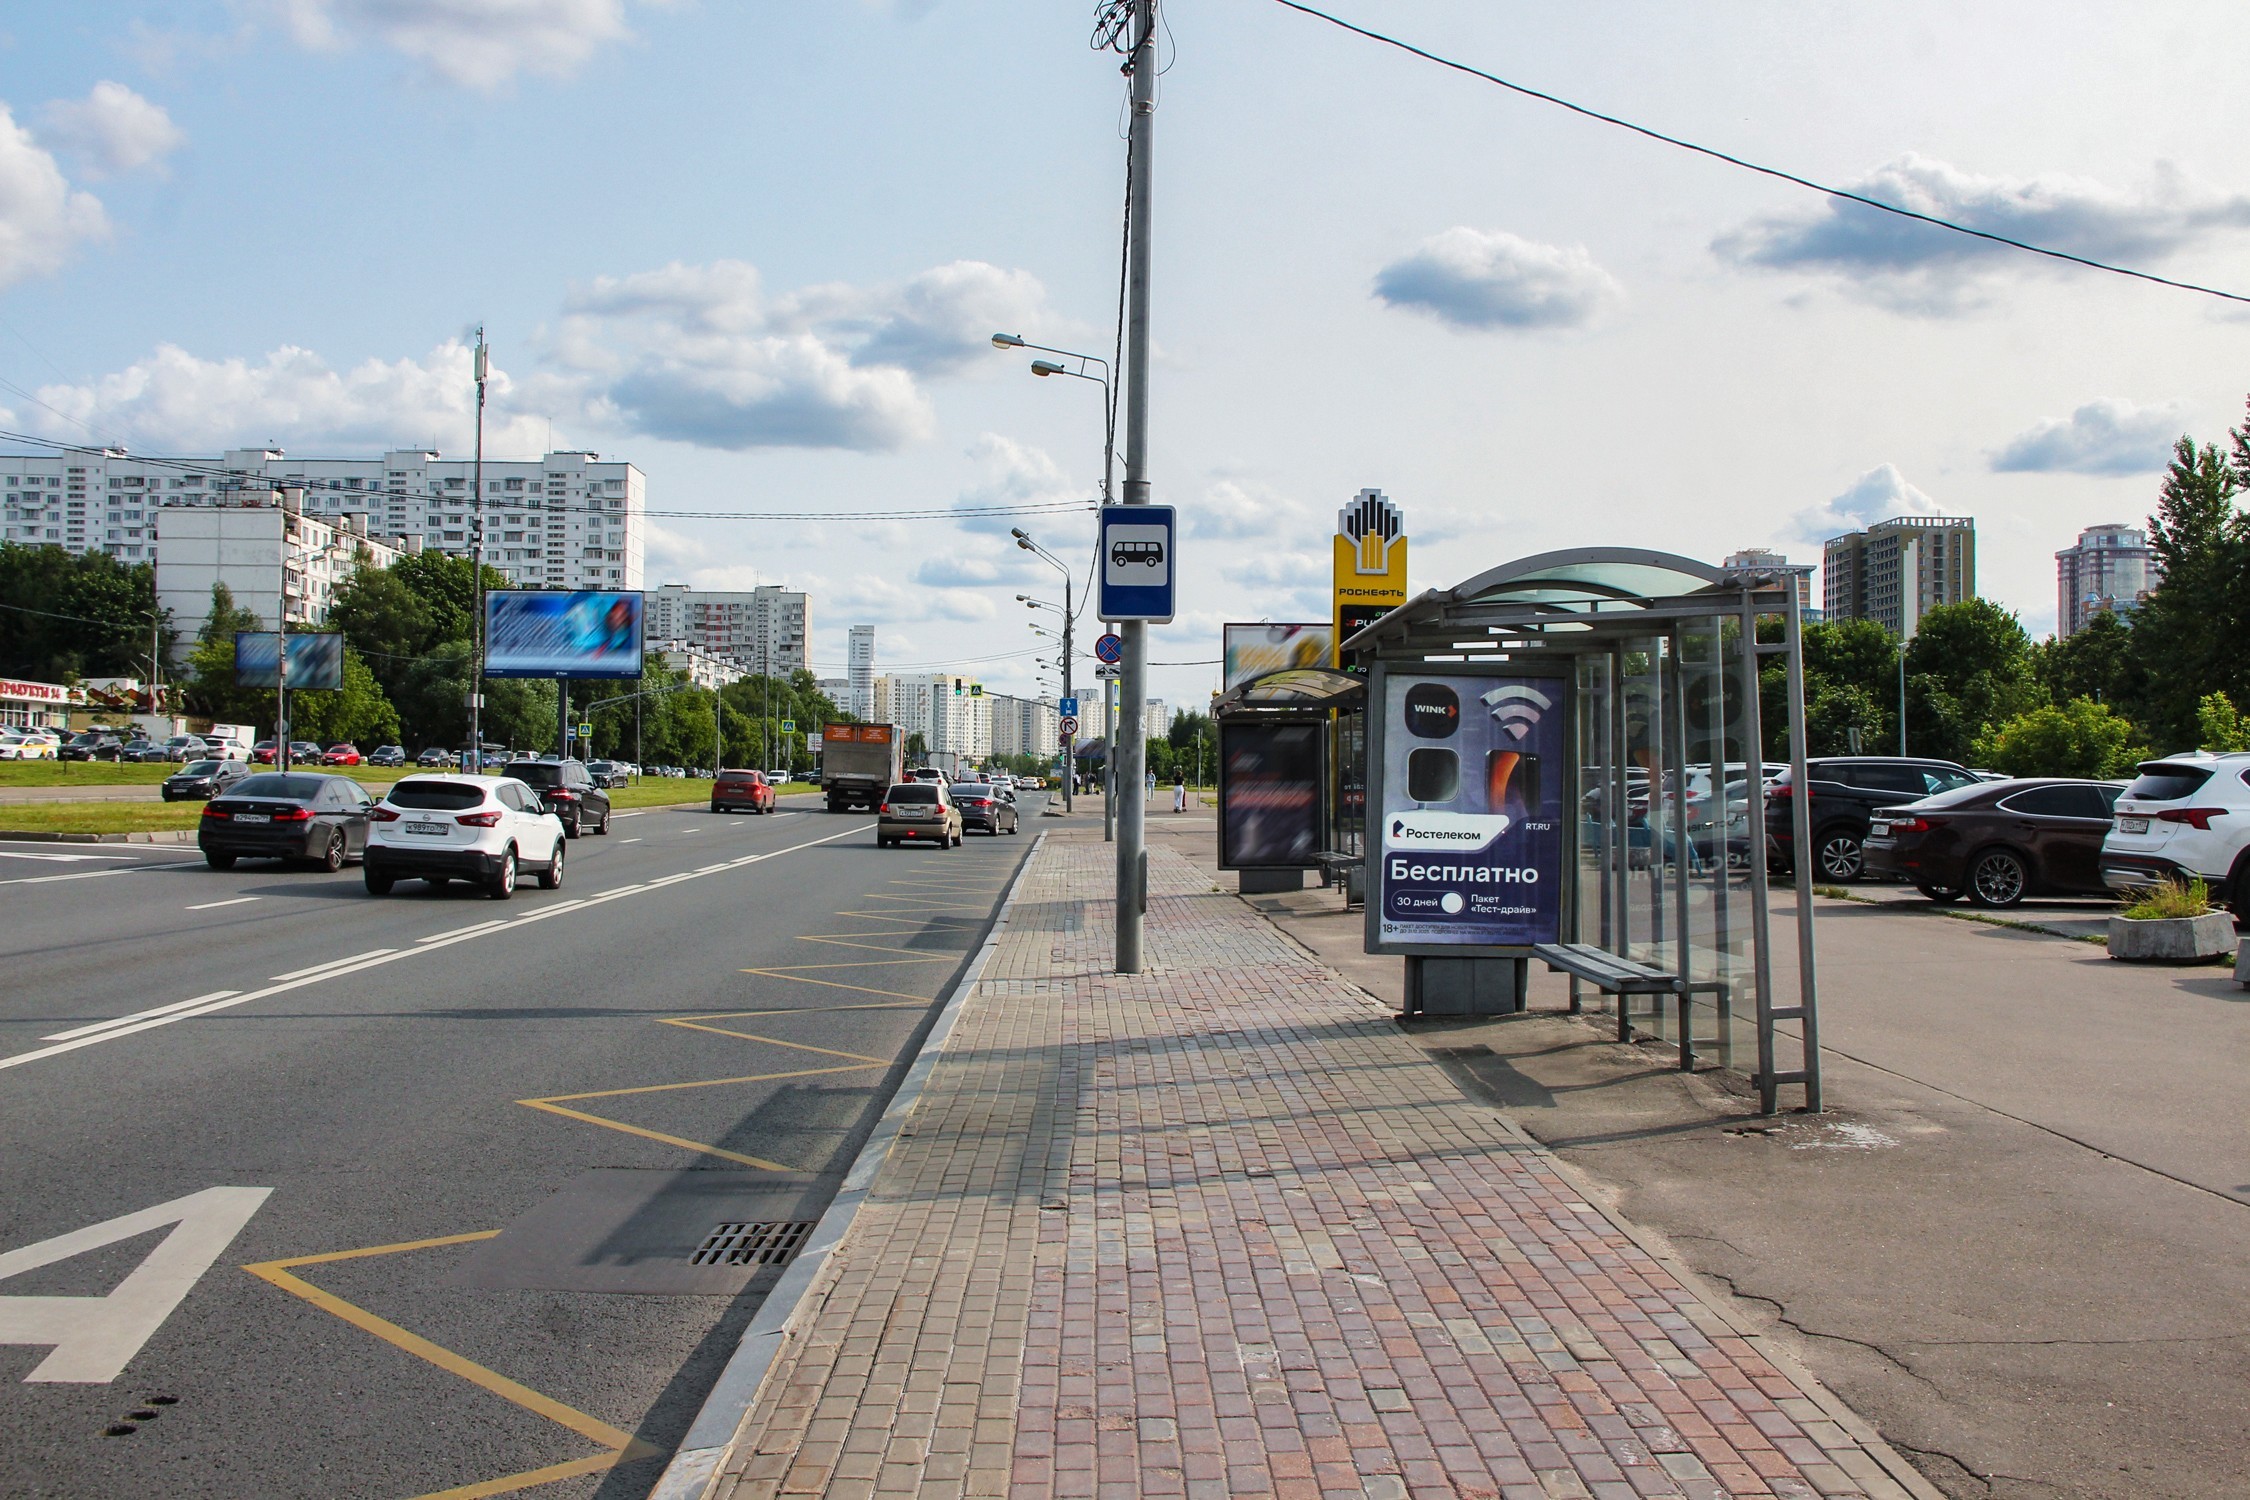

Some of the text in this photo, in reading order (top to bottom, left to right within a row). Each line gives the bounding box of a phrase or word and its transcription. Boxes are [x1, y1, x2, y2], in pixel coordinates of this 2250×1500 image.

[1338, 588, 1404, 597] РОСНЕФТЬ
[1414, 704, 1446, 715] WINK
[1525, 822, 1550, 831] RT.RU
[1406, 828, 1481, 840] Ростелеком
[1391, 859, 1539, 884] Бесплатно
[1397, 897, 1438, 907] 30 дней
[1471, 894, 1500, 903] Пакет
[1471, 904, 1537, 915] «Тест-драйв»
[1383, 924, 1399, 933] 18+
